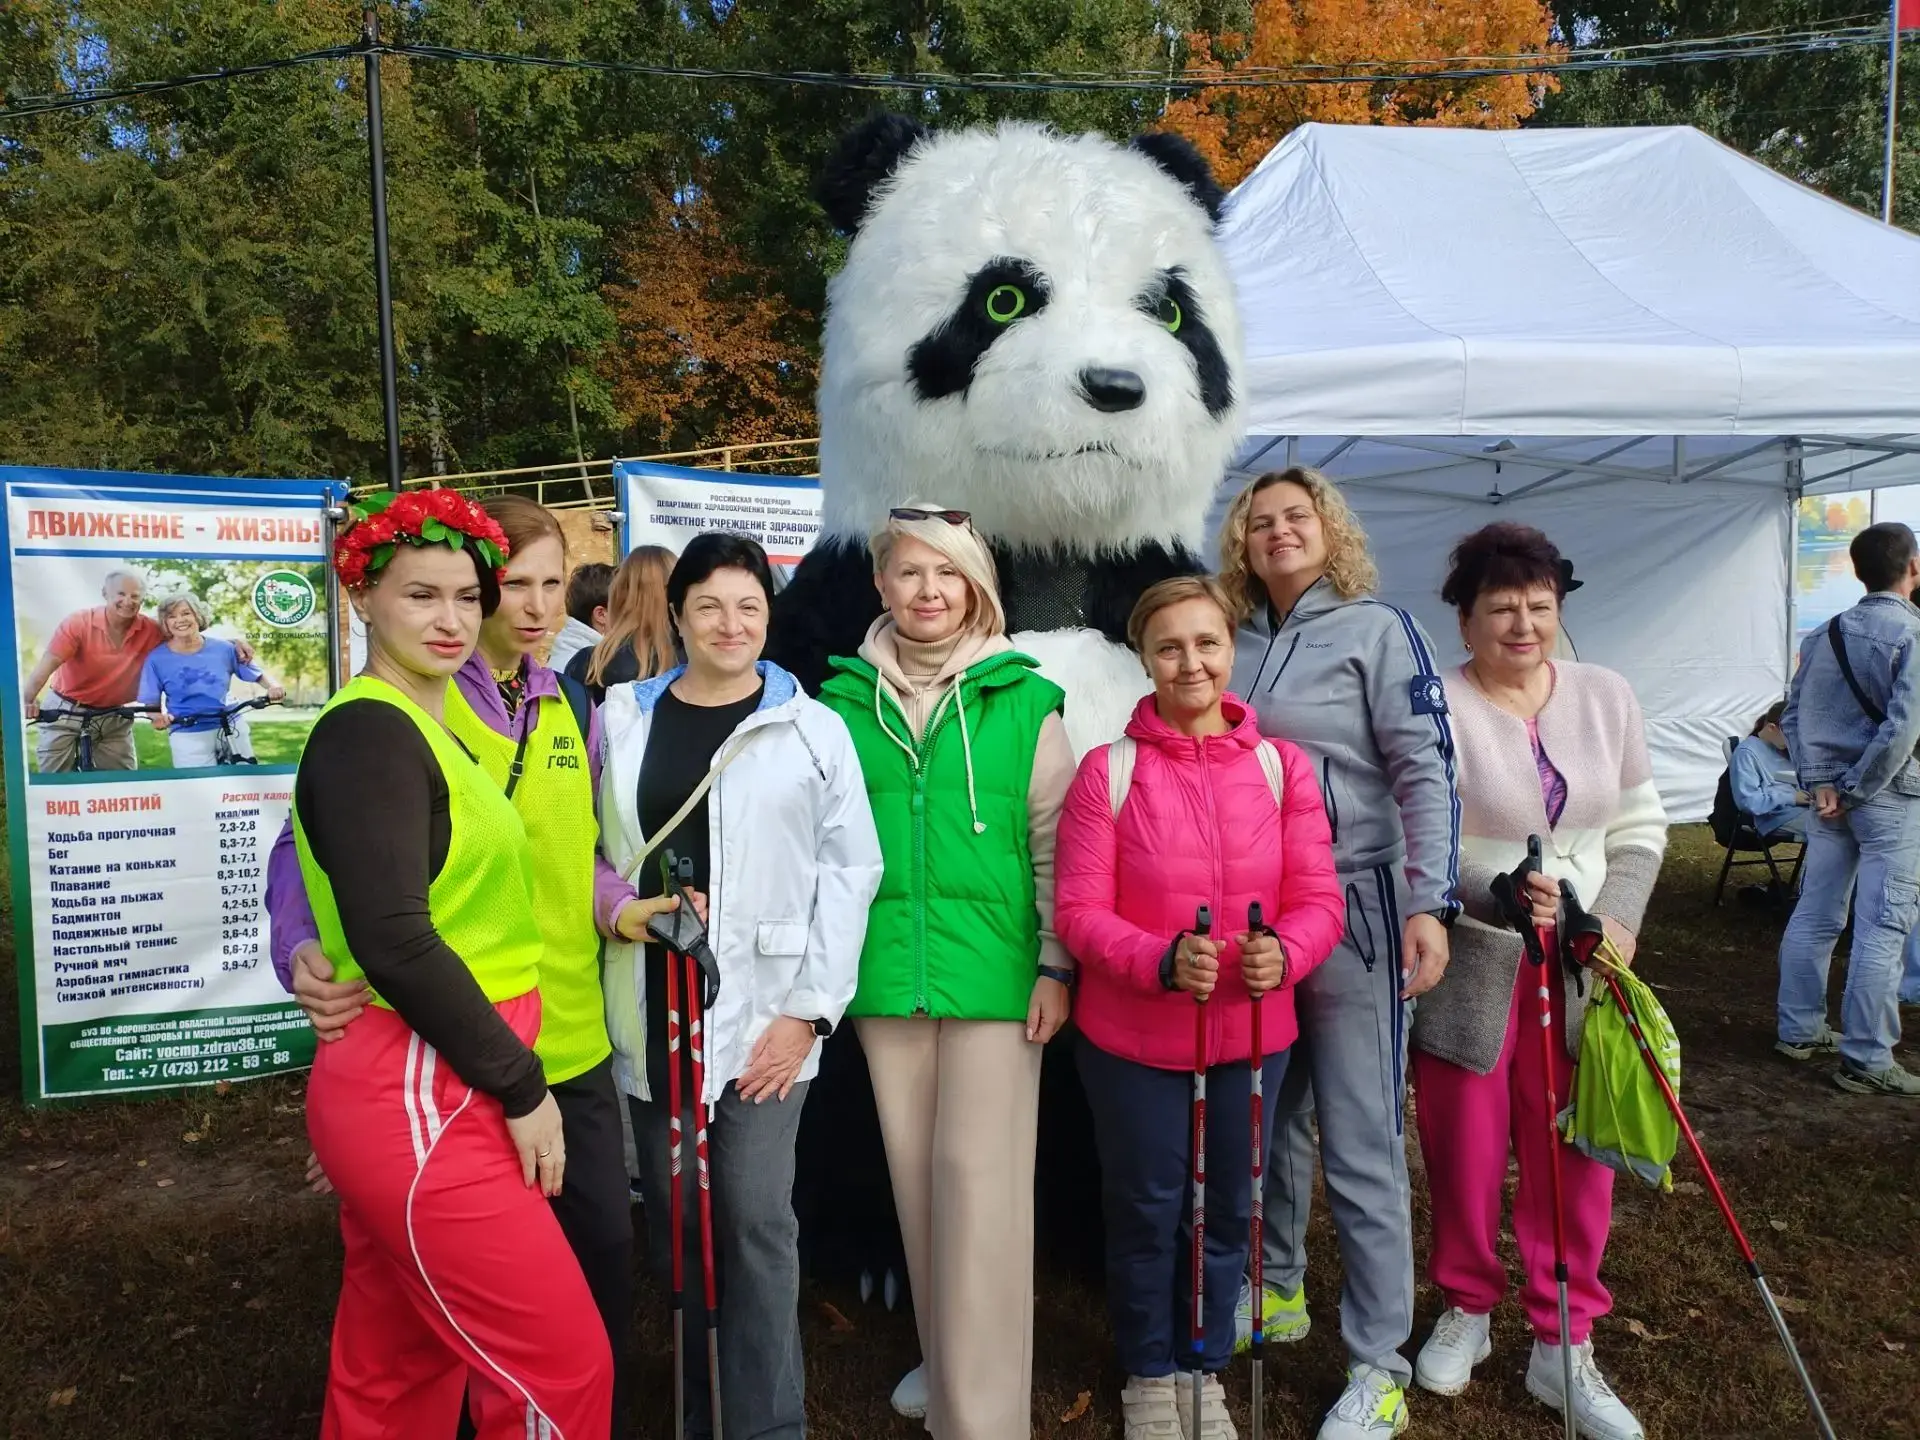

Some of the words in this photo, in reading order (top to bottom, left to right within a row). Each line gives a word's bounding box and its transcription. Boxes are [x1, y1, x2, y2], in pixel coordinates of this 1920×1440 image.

[710, 494, 752, 503] РОССИЙСКАЯ
[755, 497, 791, 506] ФЕДЕРАЦИЯ
[657, 500, 702, 510] ДЕПАРТАМЕНТ
[705, 504, 765, 514] ЗДРАВООХРАНЕНИЯ
[767, 507, 813, 516] ВОРОНЕЖСКОЙ
[27, 510, 185, 540] ДВИЖЕНИЕ
[216, 516, 321, 544] ЖИЗНЬ!
[650, 514, 706, 527] БЮДЖЕТНОЕ
[710, 518, 767, 531] УЧРЕЖДЕНИЕ
[767, 534, 805, 546] ОБЛАСТИ
[553, 736, 575, 750] МБУ
[46, 799, 81, 817] ВИД
[87, 793, 162, 814] ЗАНЯТИЙ
[222, 792, 260, 803] Расход
[215, 808, 260, 820] ккал/мин
[220, 821, 256, 834] 2,3-2,8
[48, 828, 93, 845] Ходьба
[97, 826, 177, 843] прогулочная
[220, 837, 256, 850] 6,3-7,2
[48, 848, 69, 861] Бег
[220, 853, 256, 865] 6,1-7,1
[49, 861, 101, 877] Катание
[106, 864, 121, 874] на
[125, 858, 177, 872] коньках
[217, 868, 260, 880] 8,3-10,2
[50, 878, 111, 892] Плавание
[221, 884, 257, 896] 5,7-7,1
[51, 895, 97, 910] Ходьба
[100, 895, 116, 906] на
[120, 890, 164, 904] лыжах
[222, 898, 258, 910] 4,2-5,5
[52, 910, 121, 926] Бадминтон
[222, 912, 258, 925] 3,9-4,7
[52, 924, 128, 942] Подвижные
[132, 922, 163, 937] игры
[222, 928, 258, 940] 3,6-4,8
[53, 941, 131, 957] Настольный
[135, 935, 178, 951] теннис
[223, 943, 258, 956] 6,6-7,9
[54, 956, 100, 974] Ручной
[103, 957, 128, 968] мяч
[222, 958, 258, 972] 3,9-4,7
[55, 972, 115, 989] Аэробная
[119, 963, 190, 983] гимнастика
[56, 986, 107, 1003] (низкой
[110, 976, 205, 998] интенсивности)
[81, 1028, 98, 1038] БУЗ
[100, 1026, 112, 1036] ВО
[179, 1016, 224, 1029] ОБЛАСТНОЙ
[227, 1011, 283, 1026] КЛИНИЧЕСКИЙ
[70, 1035, 138, 1049] ОБЩЕСТВЕННОГО
[140, 1032, 182, 1044] ЗДОРОВЬЯ
[184, 1030, 191, 1040] И
[193, 1025, 252, 1040] МЕДИЦИНСКОЙ
[254, 1018, 311, 1034] ПРОФИЛАКТИК
[116, 1047, 152, 1062] Сайт:
[156, 1036, 277, 1060] vocmp.zdrav36.ru;
[102, 1067, 134, 1082] Тел.:
[138, 1064, 157, 1078] +7
[162, 1060, 198, 1078] (473)
[203, 1058, 229, 1074] 212
